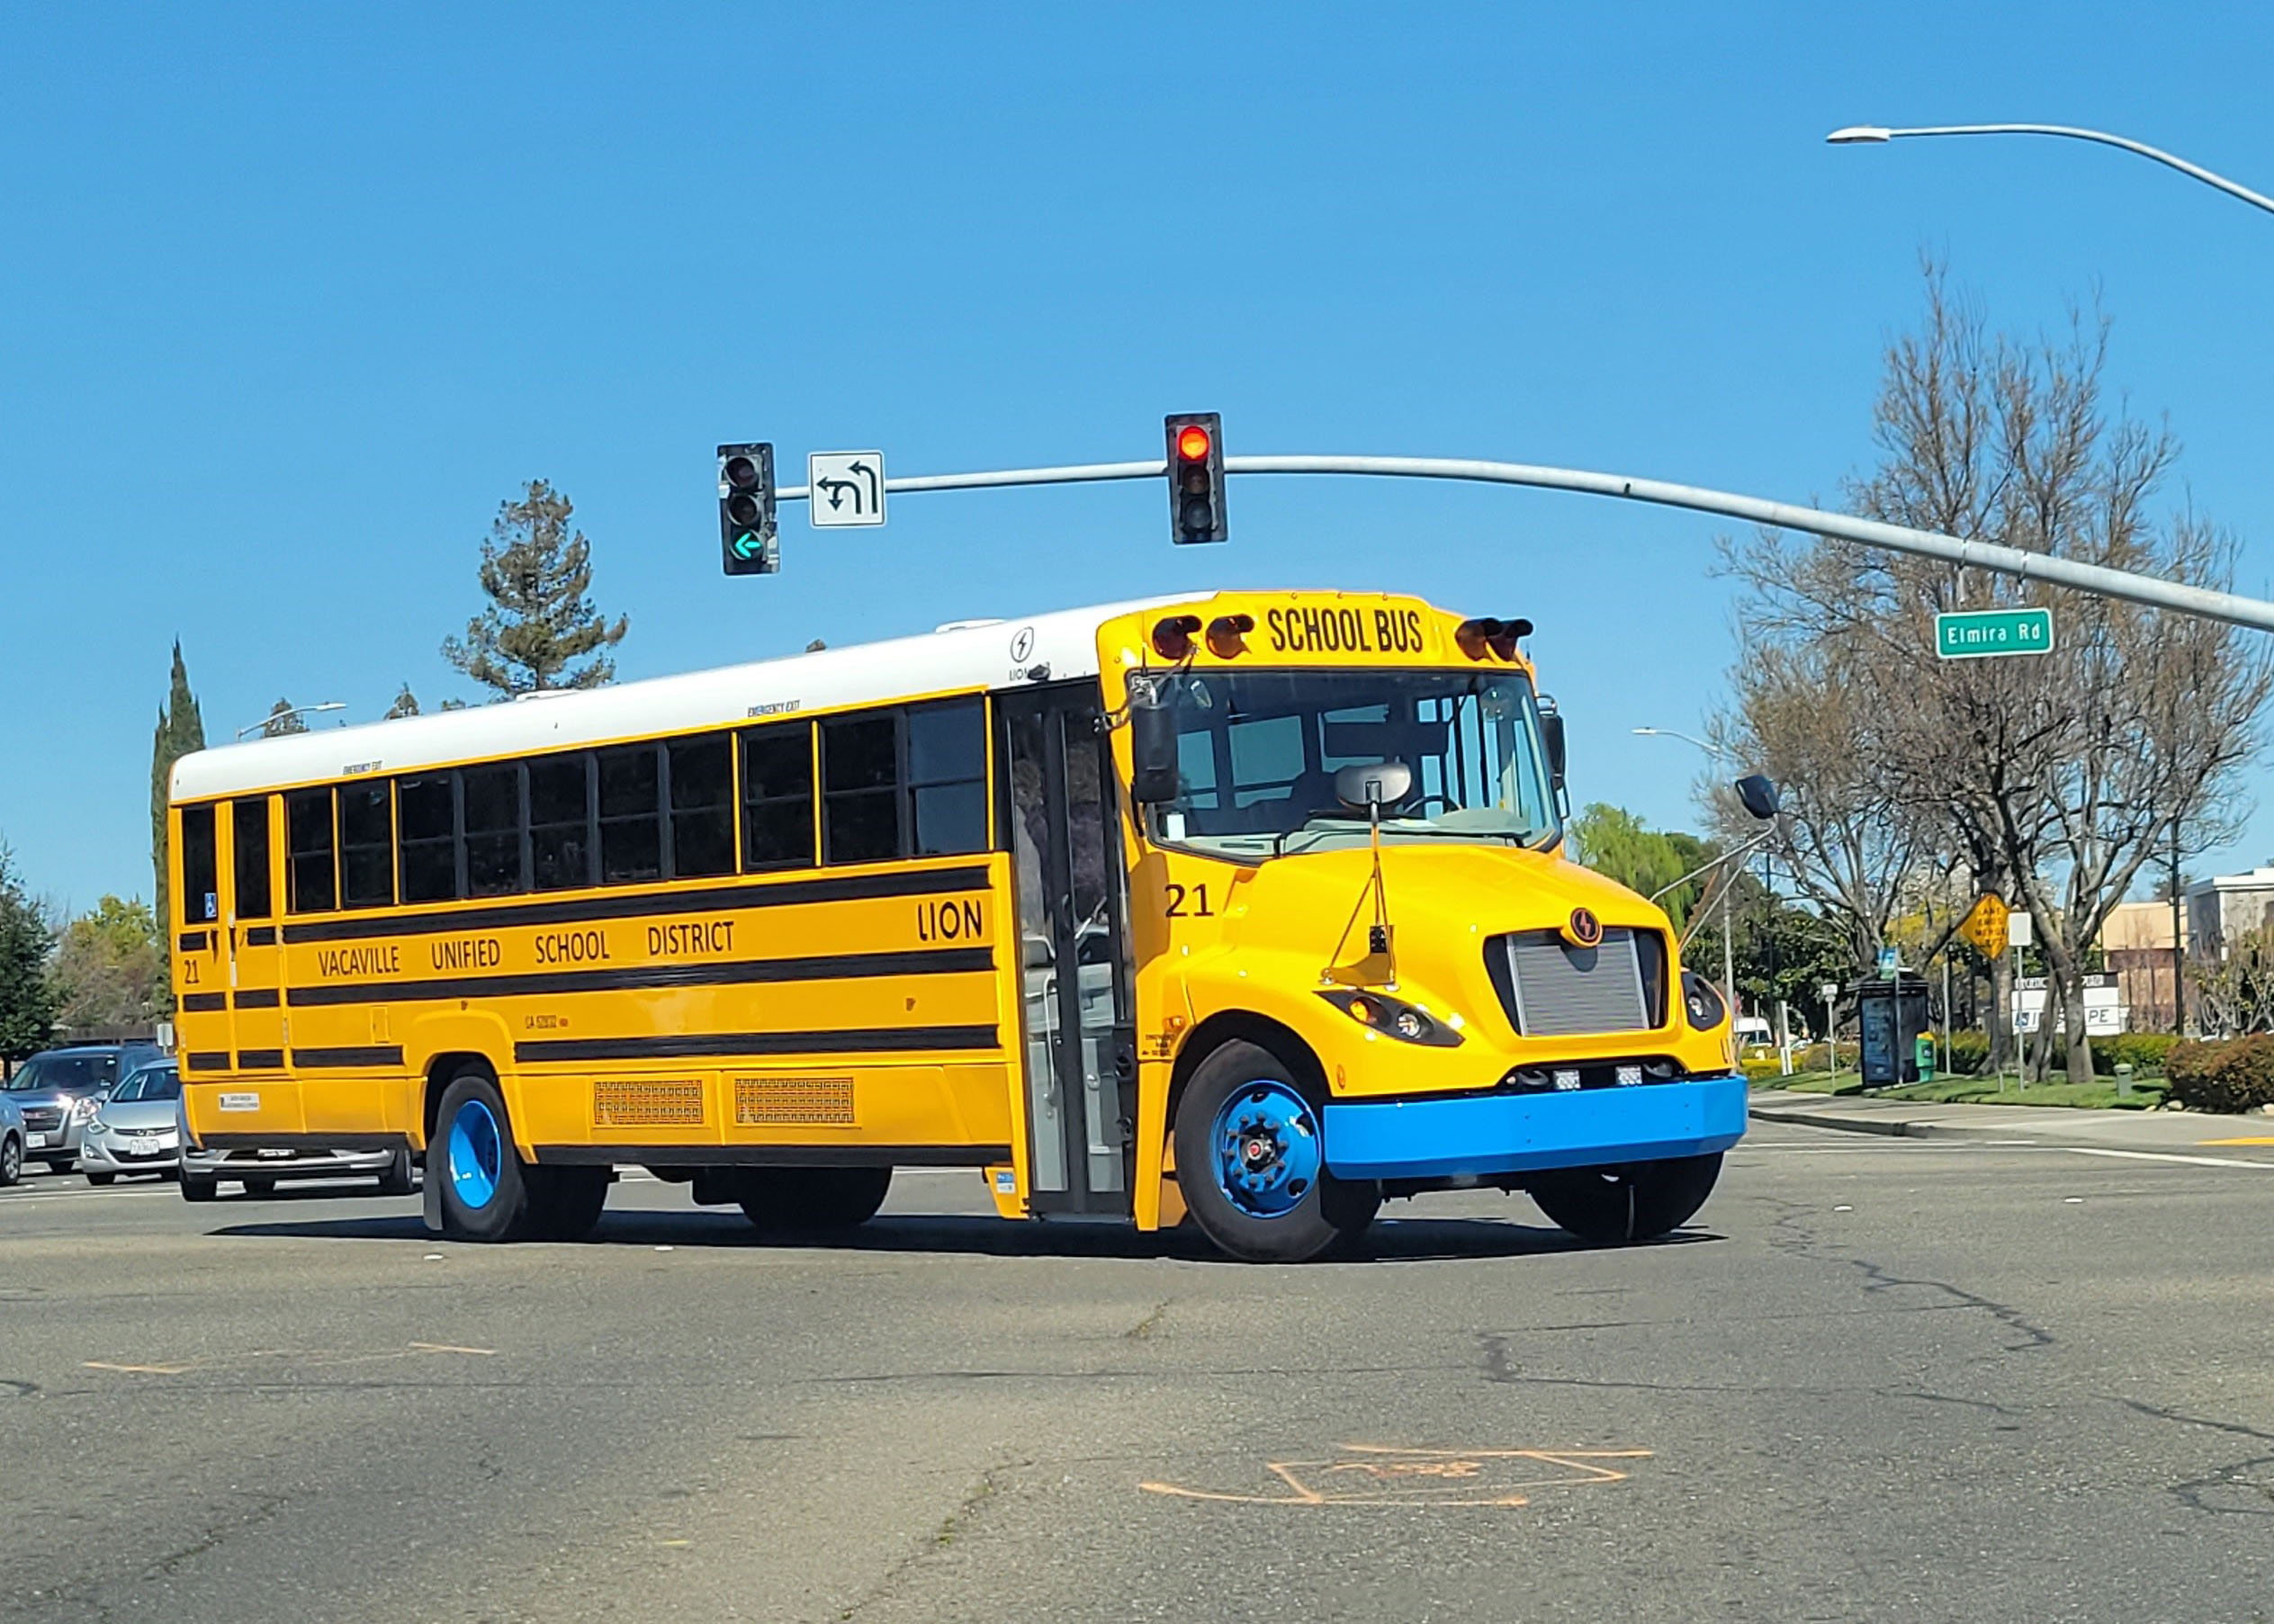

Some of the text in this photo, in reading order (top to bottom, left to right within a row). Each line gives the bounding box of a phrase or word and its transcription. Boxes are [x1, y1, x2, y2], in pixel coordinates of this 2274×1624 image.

[1267, 607, 1423, 653] SCHOOL BUS
[1947, 623, 2040, 644] Elmira Rd
[1165, 883, 1214, 918] 21
[918, 899, 982, 941] LION
[318, 920, 734, 977] VACAVILLE UNIFIED SCHOOL DISTRICT
[184, 959, 200, 984] 21
